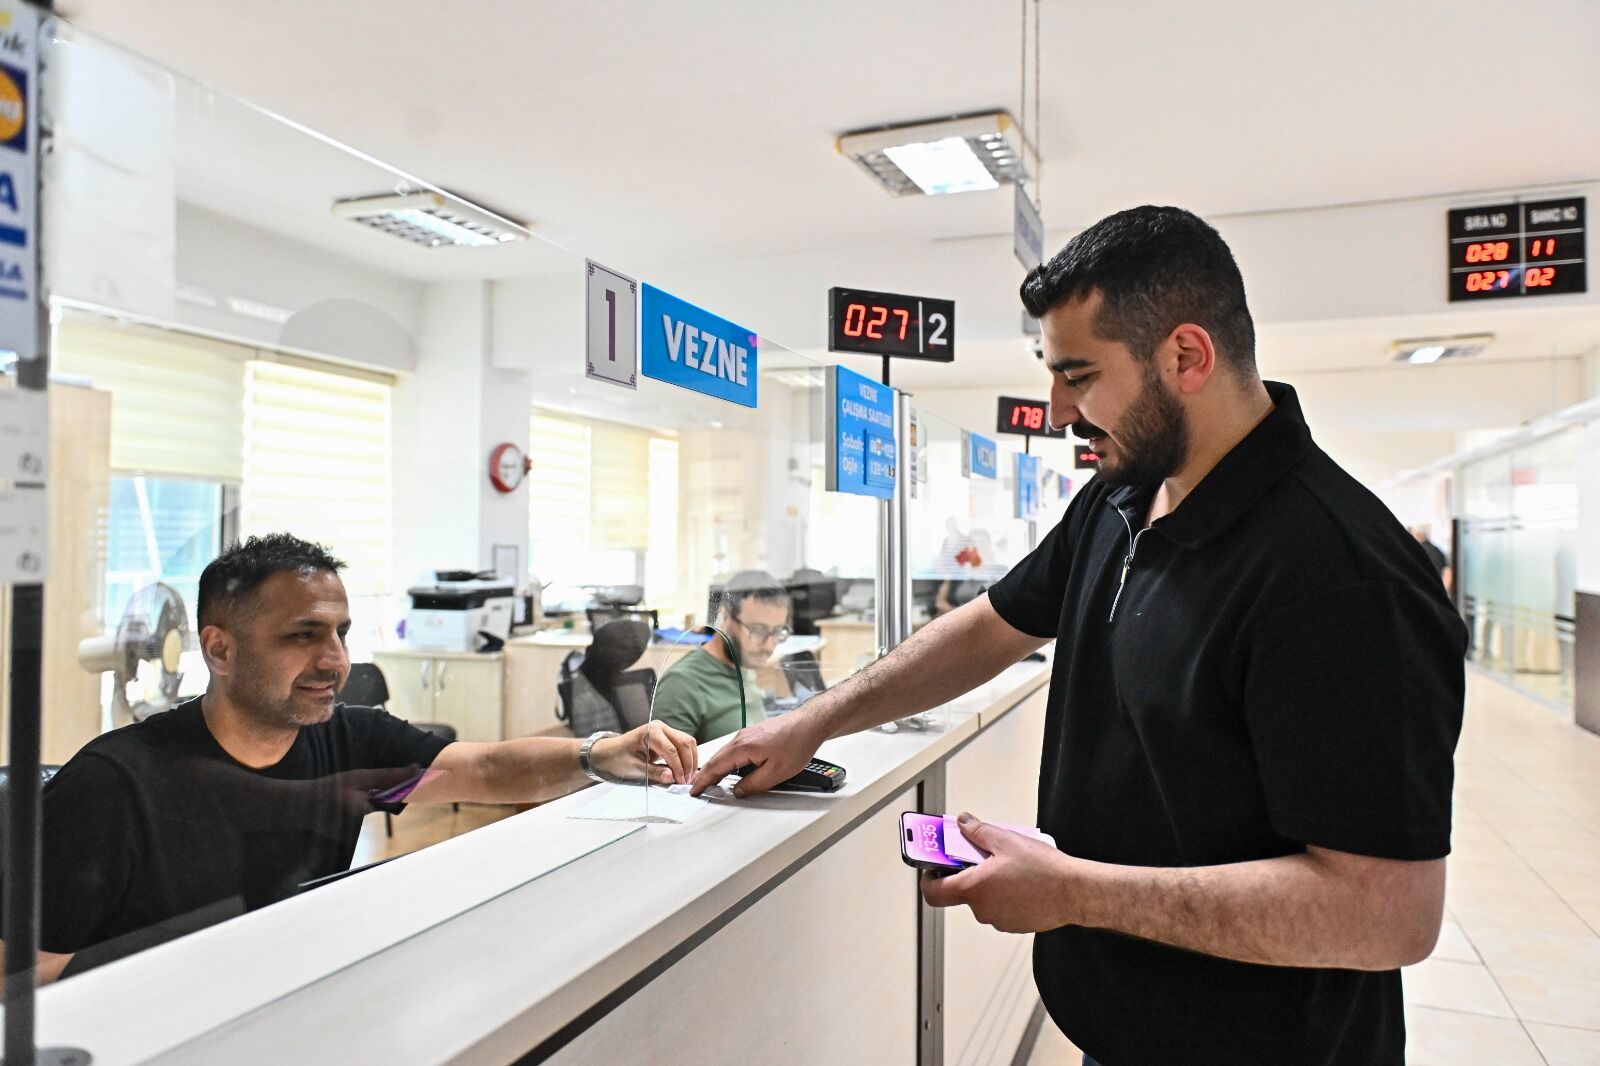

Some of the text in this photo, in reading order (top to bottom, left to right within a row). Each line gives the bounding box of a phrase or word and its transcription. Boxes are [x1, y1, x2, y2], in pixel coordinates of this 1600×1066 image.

[1531, 239, 1554, 257] 11
[1465, 267, 1555, 292] 027 02
[605, 288, 616, 362] 1
[843, 303, 948, 346] 027 2
[662, 313, 748, 387] VEZNE
[1011, 405, 1044, 429] 178
[922, 824, 940, 852] 13:35
